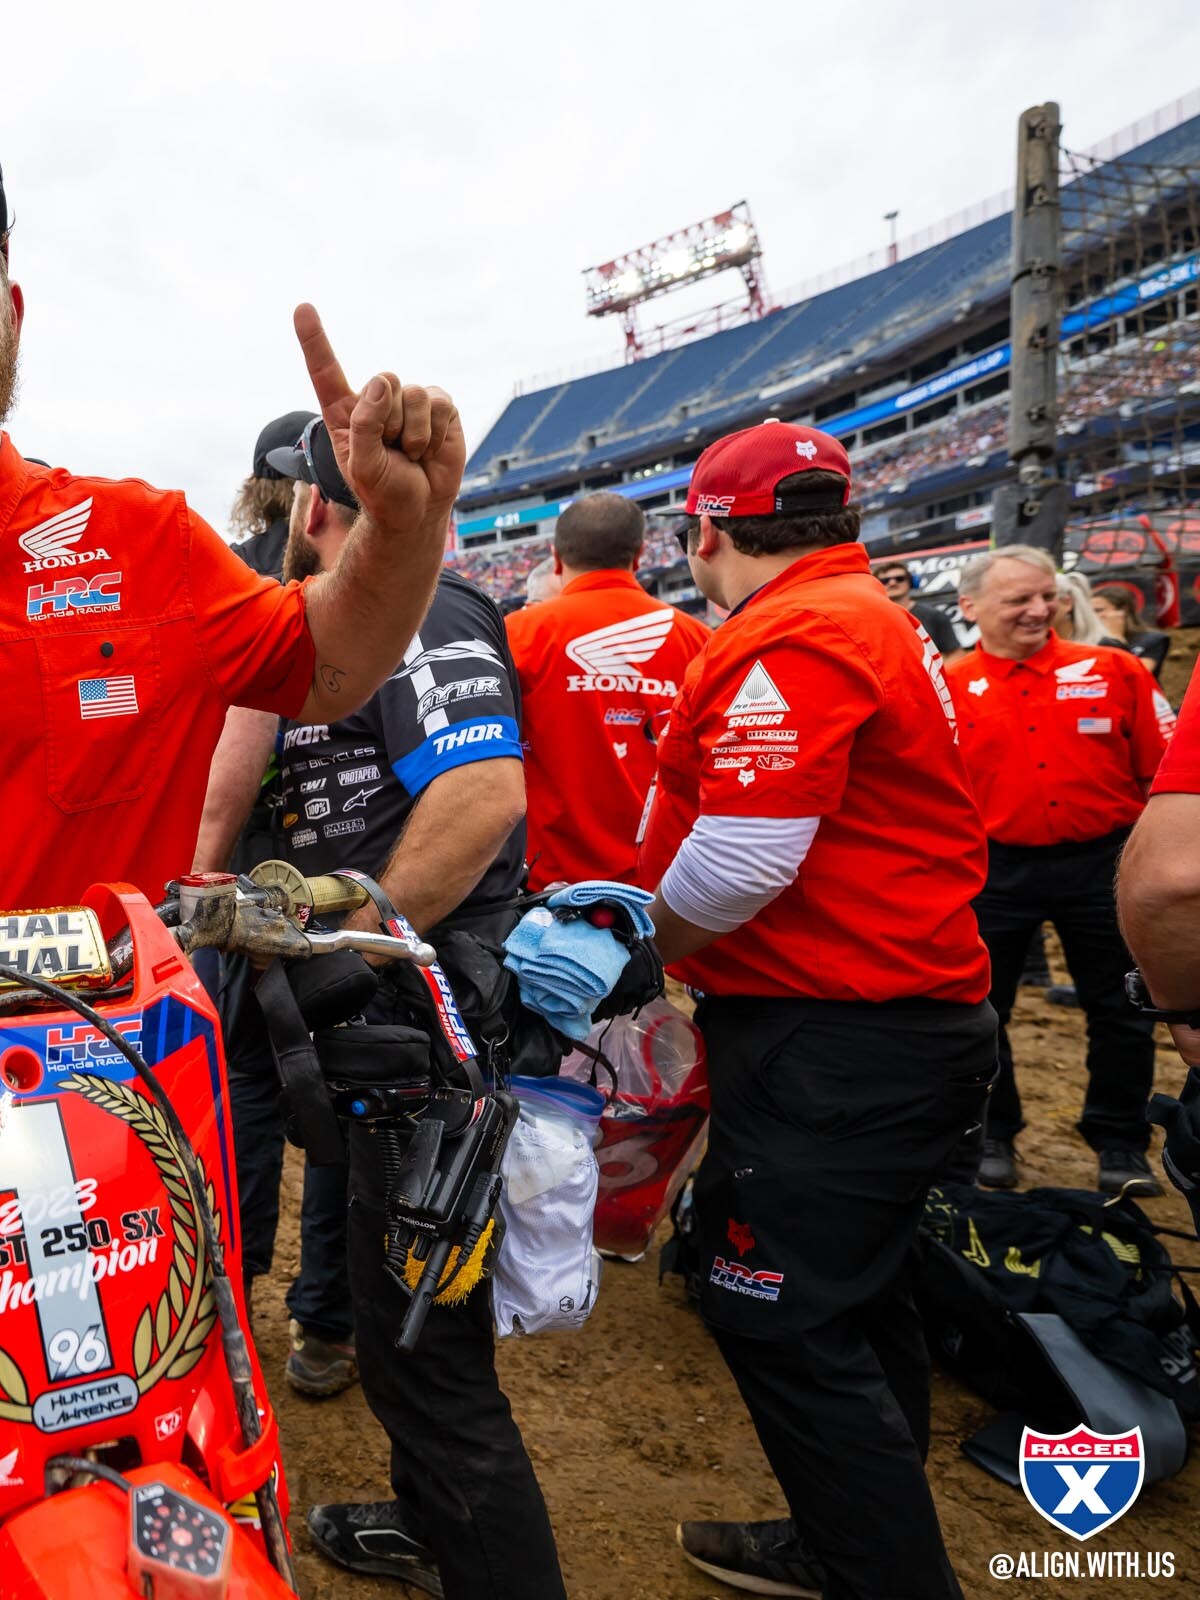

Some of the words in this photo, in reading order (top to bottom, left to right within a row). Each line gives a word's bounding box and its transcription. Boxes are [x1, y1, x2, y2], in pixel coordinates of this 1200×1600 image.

[22, 548, 112, 573] HONDA
[26, 571, 122, 616] HRC
[27, 610, 75, 622] Honda
[76, 604, 121, 615] RACING
[566, 675, 679, 697] HONDA
[417, 676, 502, 724] GYTR
[604, 708, 646, 725] HRC
[727, 714, 785, 729] SHOWA
[283, 725, 331, 751] THOR
[433, 723, 504, 756] THOR
[747, 730, 798, 739] HINSON
[309, 746, 376, 769] BICYCLES
[340, 766, 378, 784] PROTAPER
[308, 801, 326, 817] 100%
[438, 1002, 456, 1038] MIKE
[47, 1020, 143, 1064] HRC
[47, 1061, 94, 1072] Honda
[0, 1178, 98, 1235] 2023
[41, 1218, 110, 1258] 250
[121, 1207, 165, 1242] SX
[397, 1215, 437, 1230] MOTOROLA
[710, 1256, 784, 1297] HRC
[738, 1287, 779, 1302] RACING
[49, 1324, 107, 1379] 96
[50, 1381, 121, 1411] HUNTER
[41, 1397, 134, 1428] LAWRENCE
